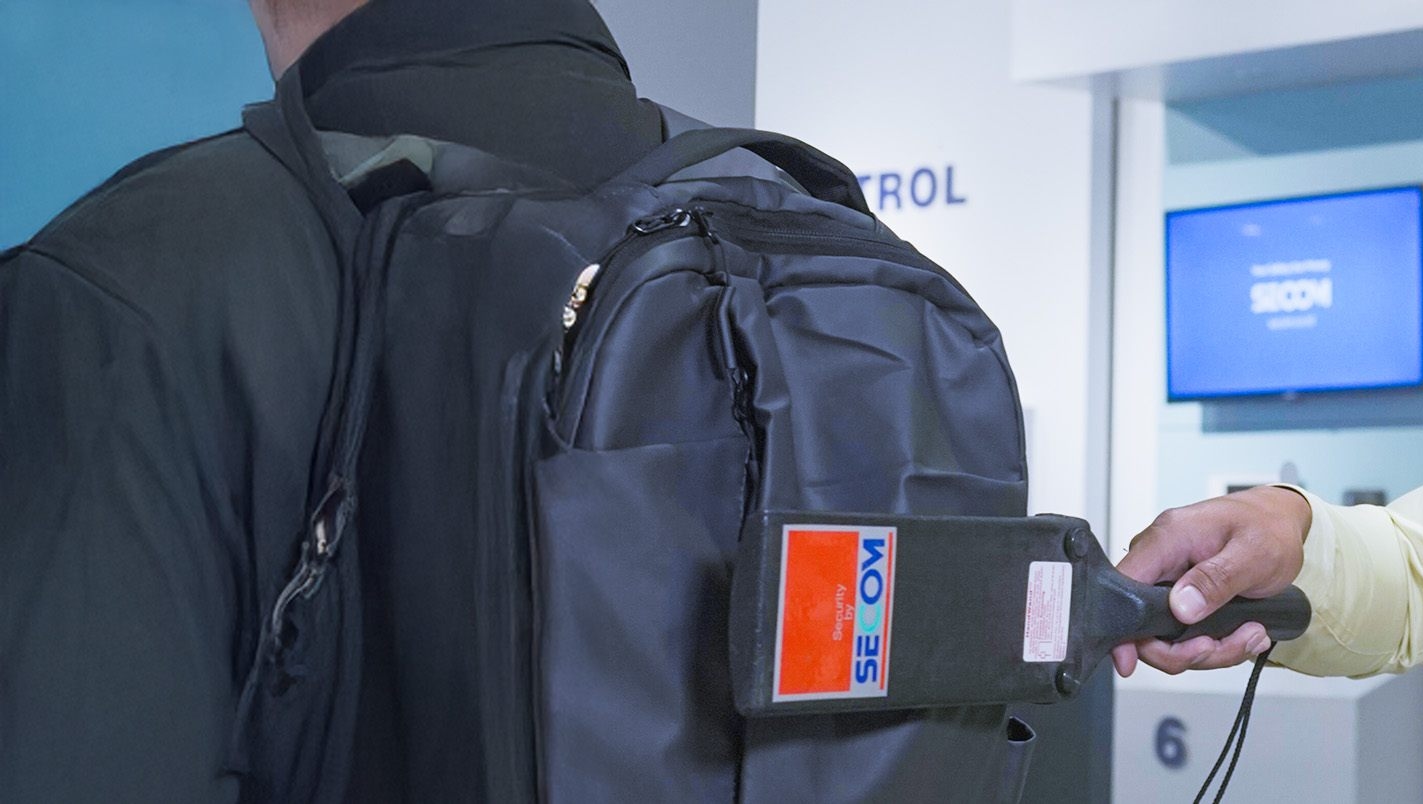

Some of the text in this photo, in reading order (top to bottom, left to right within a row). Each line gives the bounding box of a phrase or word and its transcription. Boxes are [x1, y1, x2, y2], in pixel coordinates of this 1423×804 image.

[832, 583, 847, 641] Security
[844, 604, 855, 621] by
[855, 539, 886, 684] SECOM
[1155, 716, 1188, 771] 6
